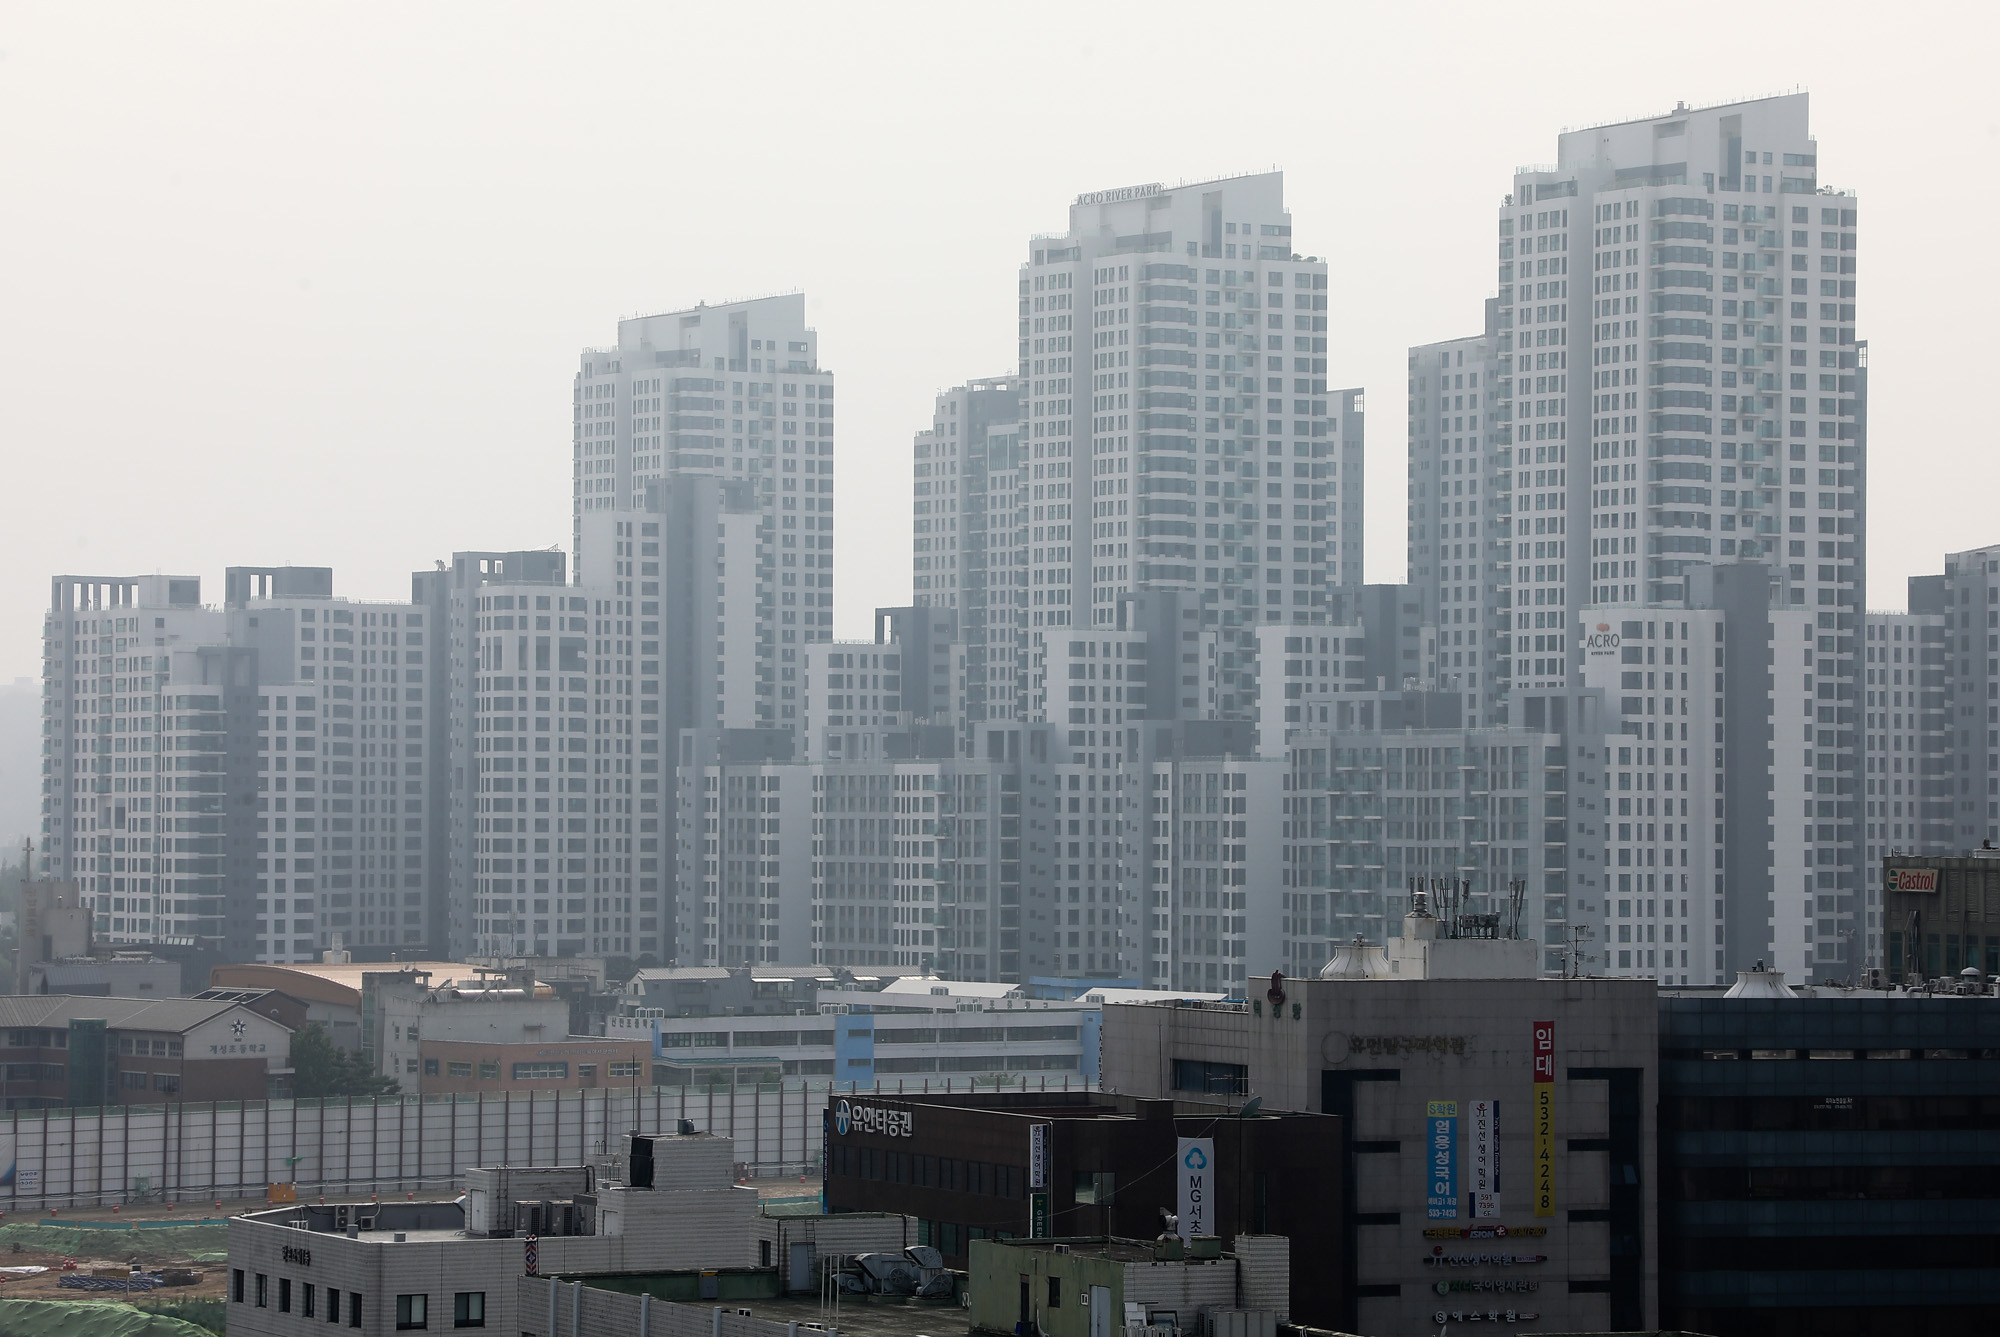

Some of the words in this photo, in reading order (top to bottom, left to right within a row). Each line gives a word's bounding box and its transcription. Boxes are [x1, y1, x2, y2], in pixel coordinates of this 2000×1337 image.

[1077, 193, 1103, 206] ACRO
[1106, 188, 1132, 203] RIVER
[1135, 184, 1158, 198] PARK
[1587, 634, 1619, 647] ACRO
[1898, 871, 1935, 890] Castrol
[1536, 1028, 1552, 1076] 임대
[852, 1105, 913, 1138] 유안타증권
[1429, 1104, 1456, 1115] S학원
[1477, 1119, 1486, 1190] 진선생어학원
[1539, 1091, 1550, 1209] 532-4248
